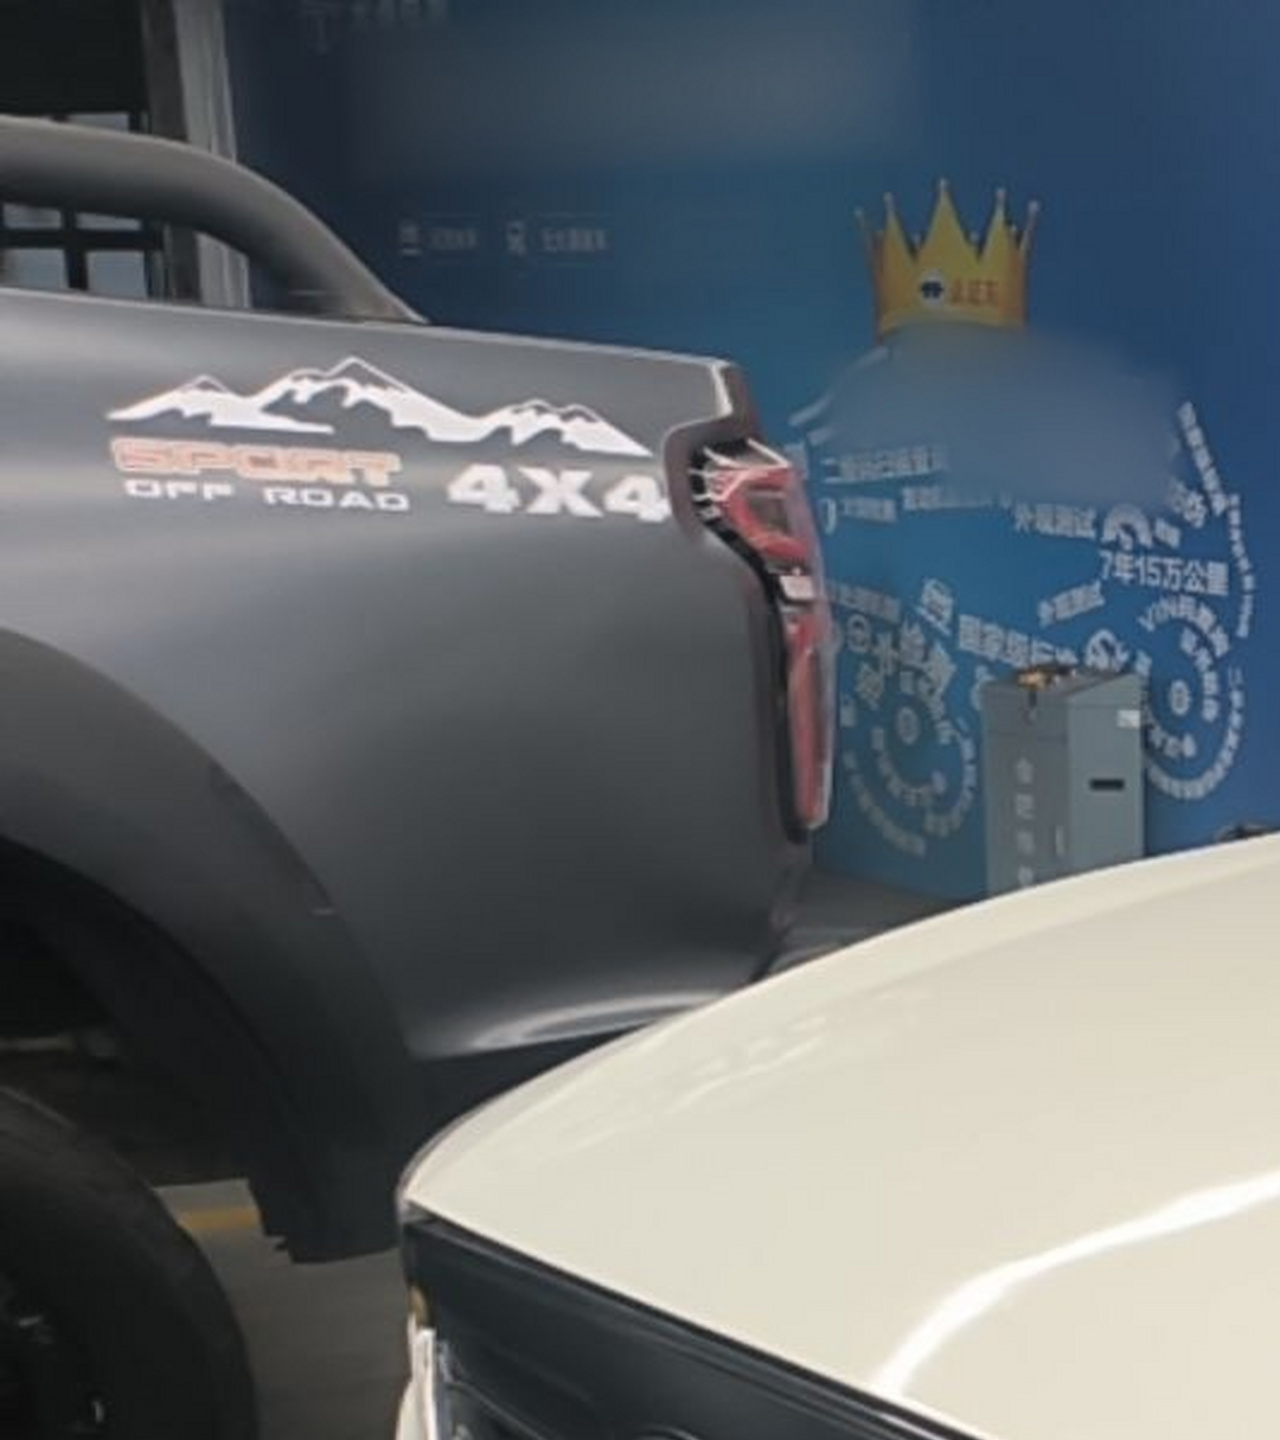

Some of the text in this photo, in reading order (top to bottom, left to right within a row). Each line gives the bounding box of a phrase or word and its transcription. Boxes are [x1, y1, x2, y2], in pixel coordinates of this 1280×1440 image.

[110, 437, 402, 486] SPORT
[124, 479, 410, 512] OFF ROAD
[449, 463, 672, 522] 4X4
[1099, 550, 1229, 597] 7年15万公里
